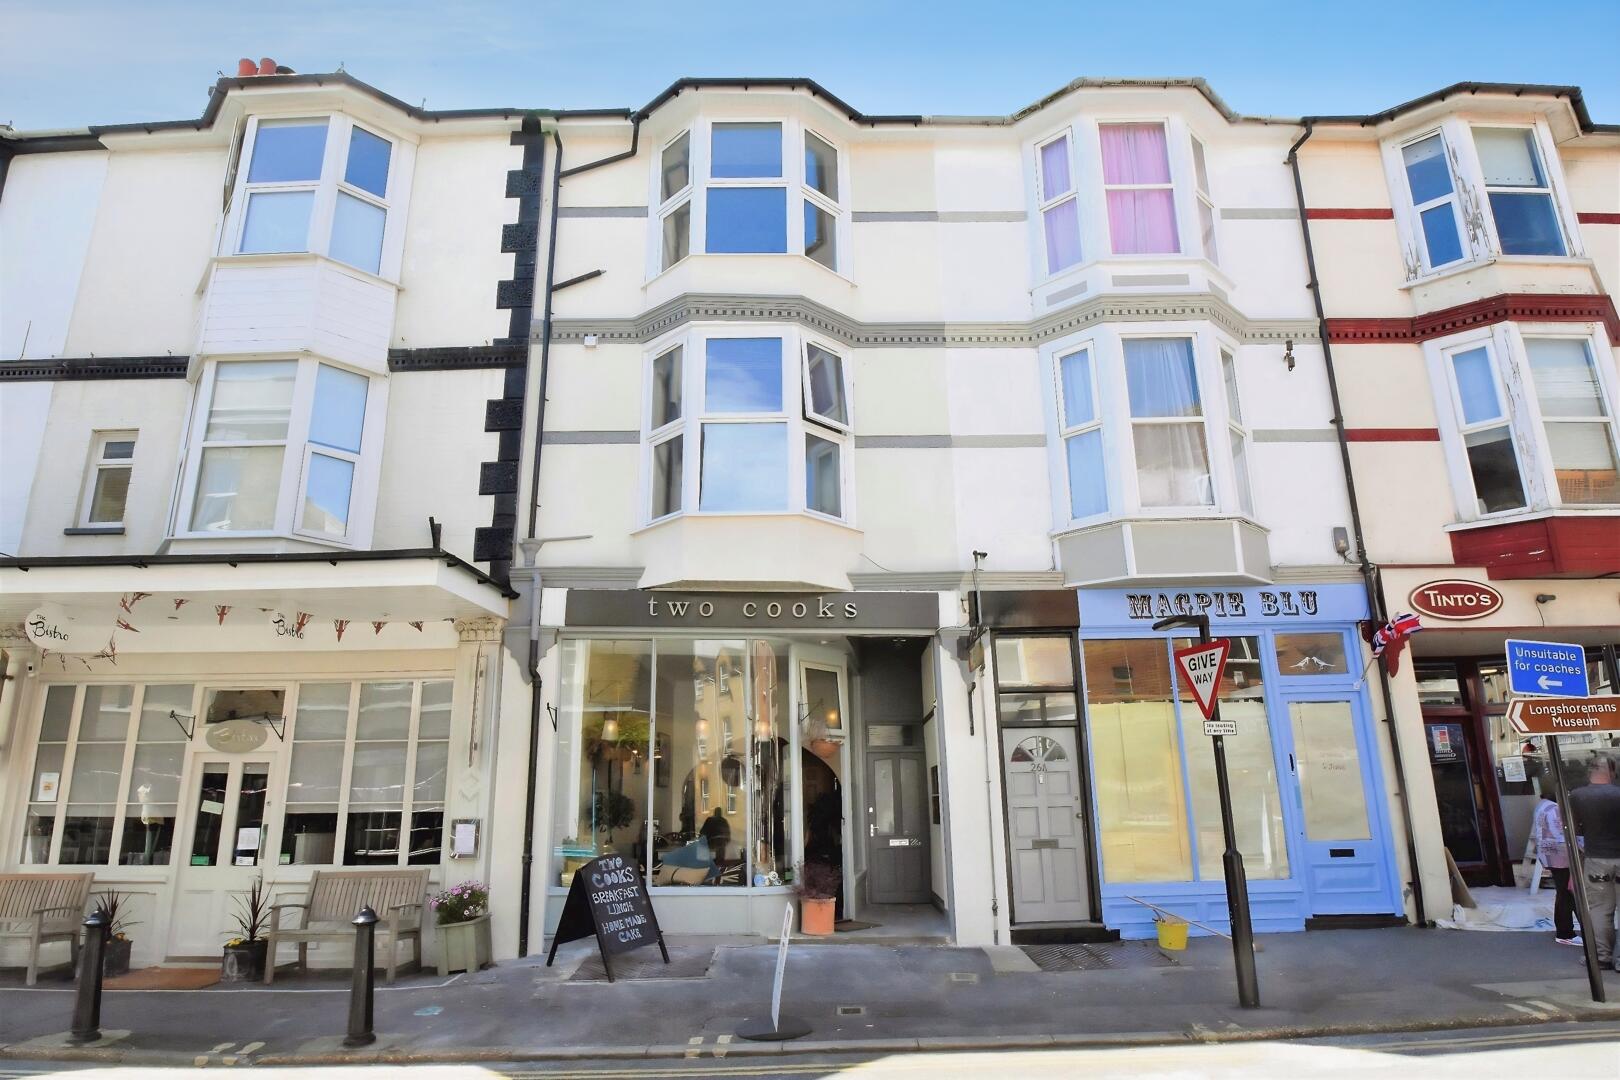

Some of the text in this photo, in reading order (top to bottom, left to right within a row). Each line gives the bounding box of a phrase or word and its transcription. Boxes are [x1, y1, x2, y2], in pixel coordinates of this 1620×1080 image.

[648, 596, 858, 618] two cooks
[1127, 591, 1318, 618] MAGPIE BLU
[29, 620, 69, 641] Bistro
[1188, 653, 1217, 671] GIVE
[1515, 648, 1577, 661] Unsuitable
[1514, 660, 1581, 675] for coaches
[1194, 672, 1213, 685] WAY
[1529, 703, 1617, 716] Longshoremans
[1552, 717, 1600, 727] Museum
[599, 857, 622, 871] TWO
[592, 867, 634, 888] COOKS
[592, 886, 639, 904] BREAKFAST
[607, 902, 634, 915] LUNCH
[602, 915, 647, 934] HOME MADE
[618, 928, 641, 943] CAKE
